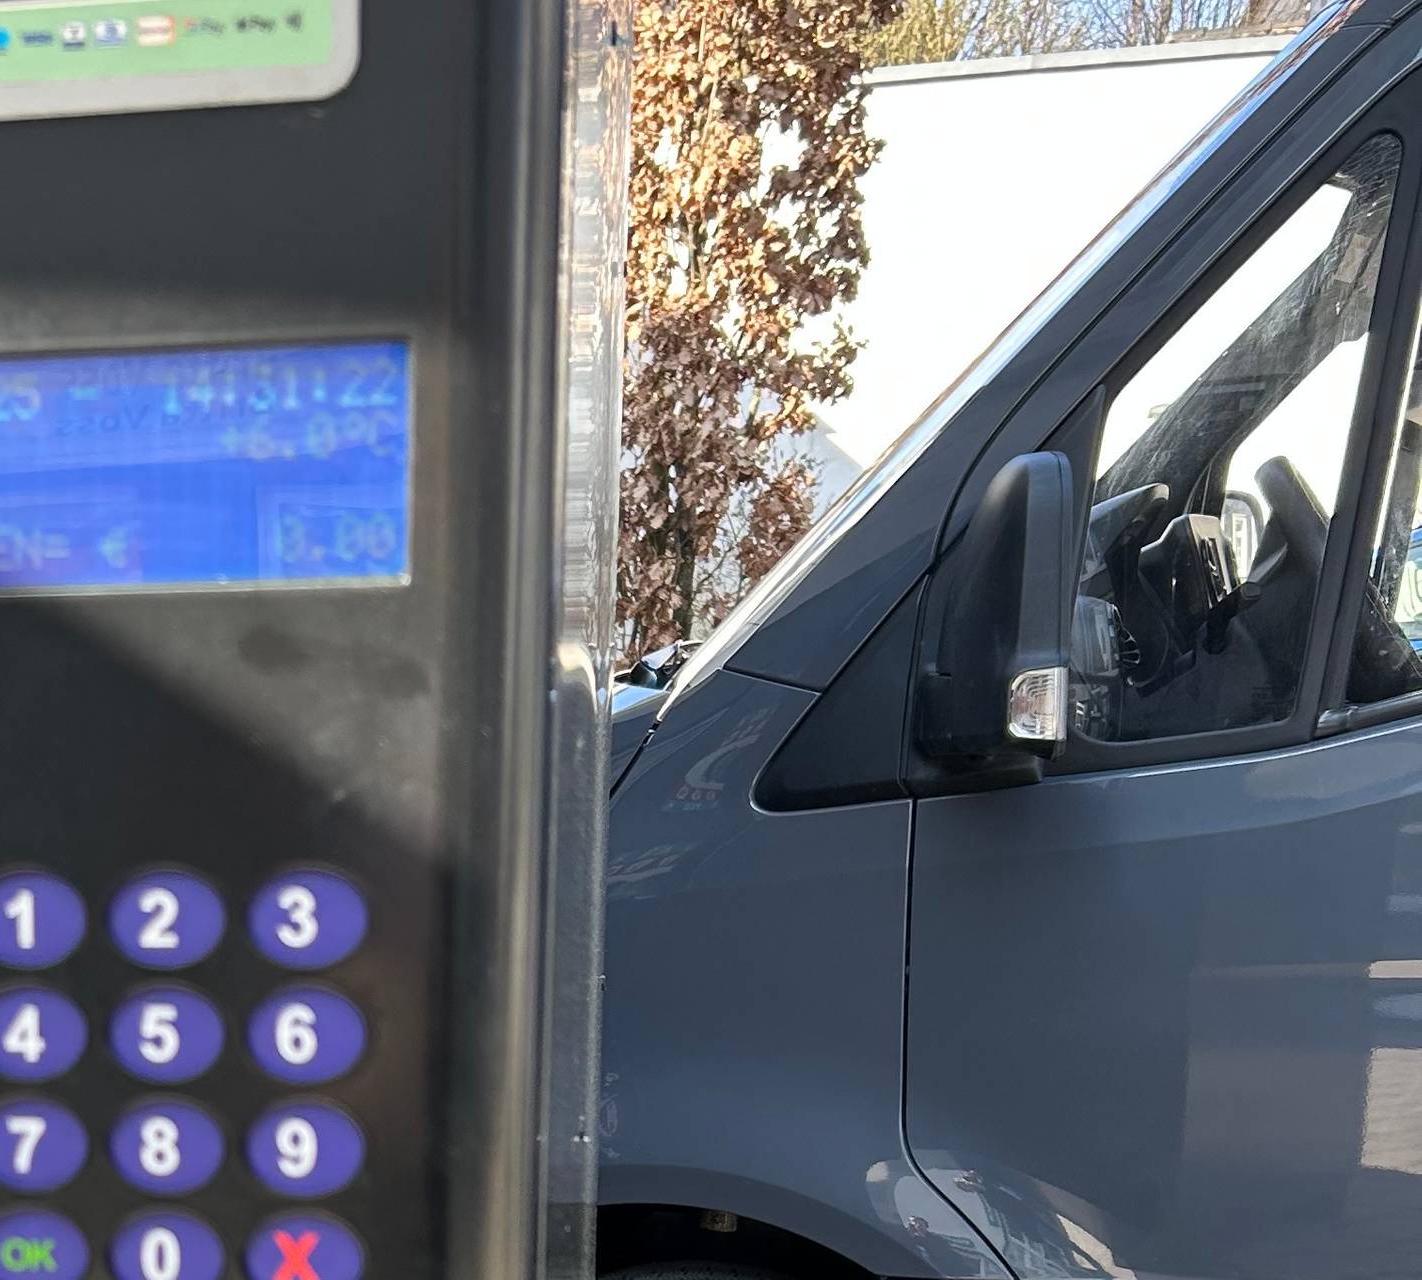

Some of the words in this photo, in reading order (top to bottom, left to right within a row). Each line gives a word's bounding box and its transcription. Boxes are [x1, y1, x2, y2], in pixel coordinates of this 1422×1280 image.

[161, 356, 398, 415] 14:31:22
[3, 888, 36, 950] 1
[138, 887, 180, 949] 2
[276, 885, 319, 949] 3
[1, 1003, 47, 1064] 4
[138, 1003, 180, 1064] 5
[274, 1002, 318, 1065] 6
[5, 1115, 47, 1175] 7
[139, 1116, 181, 1177] 8
[274, 1117, 318, 1179] 9
[0, 1237, 57, 1271] OK
[139, 1227, 181, 1280] 0
